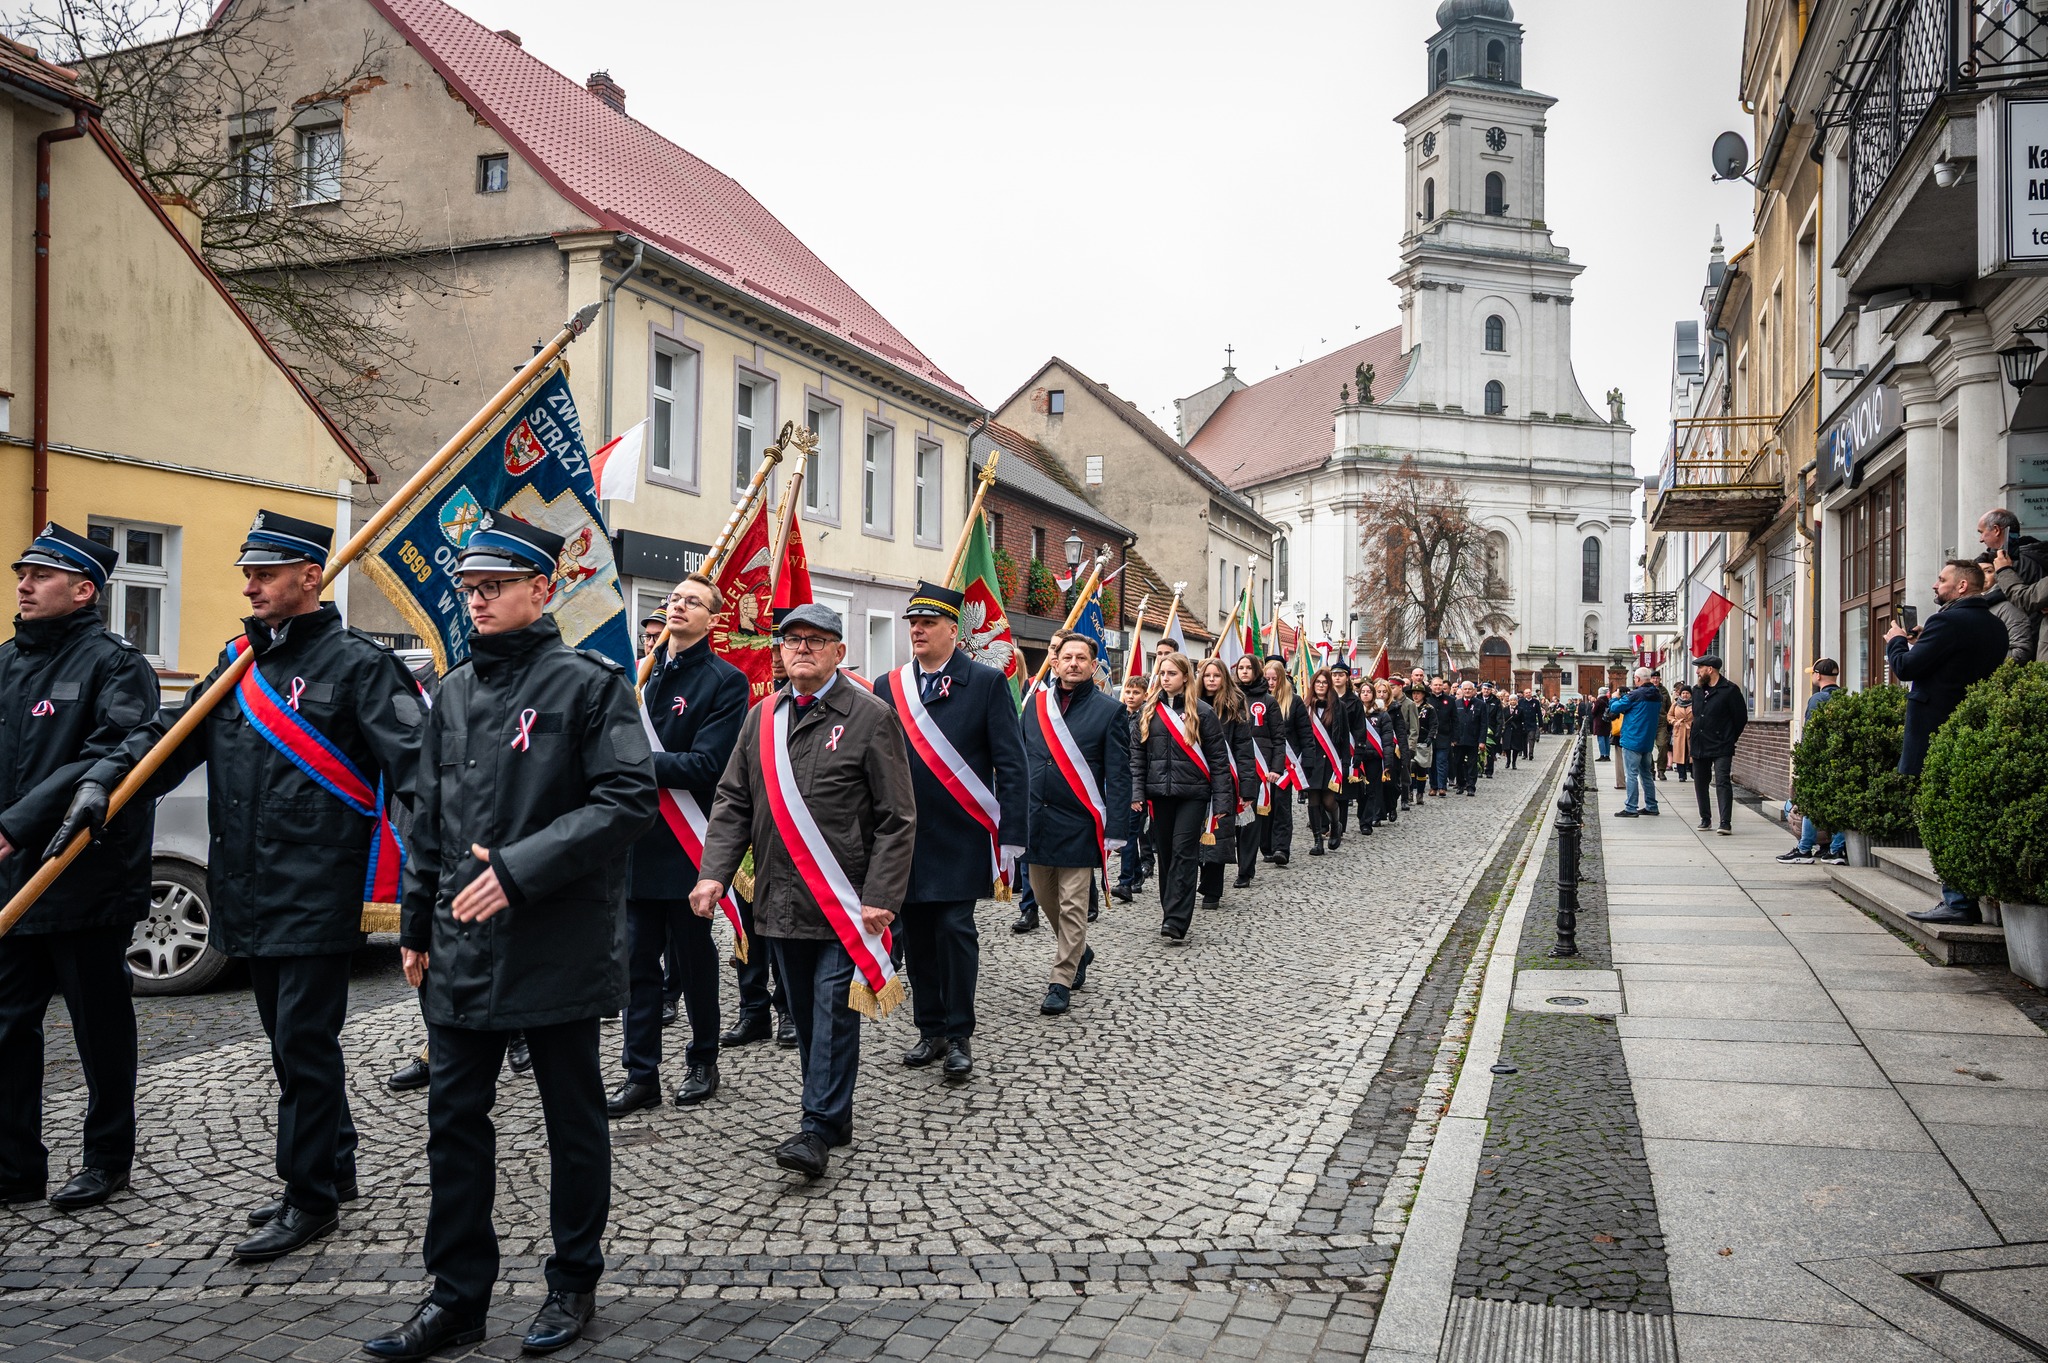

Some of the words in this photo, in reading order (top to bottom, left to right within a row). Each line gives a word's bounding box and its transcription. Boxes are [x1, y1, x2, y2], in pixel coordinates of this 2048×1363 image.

[531, 407, 589, 478] STRAŻY
[398, 541, 432, 583] 1999
[437, 589, 455, 615] W
